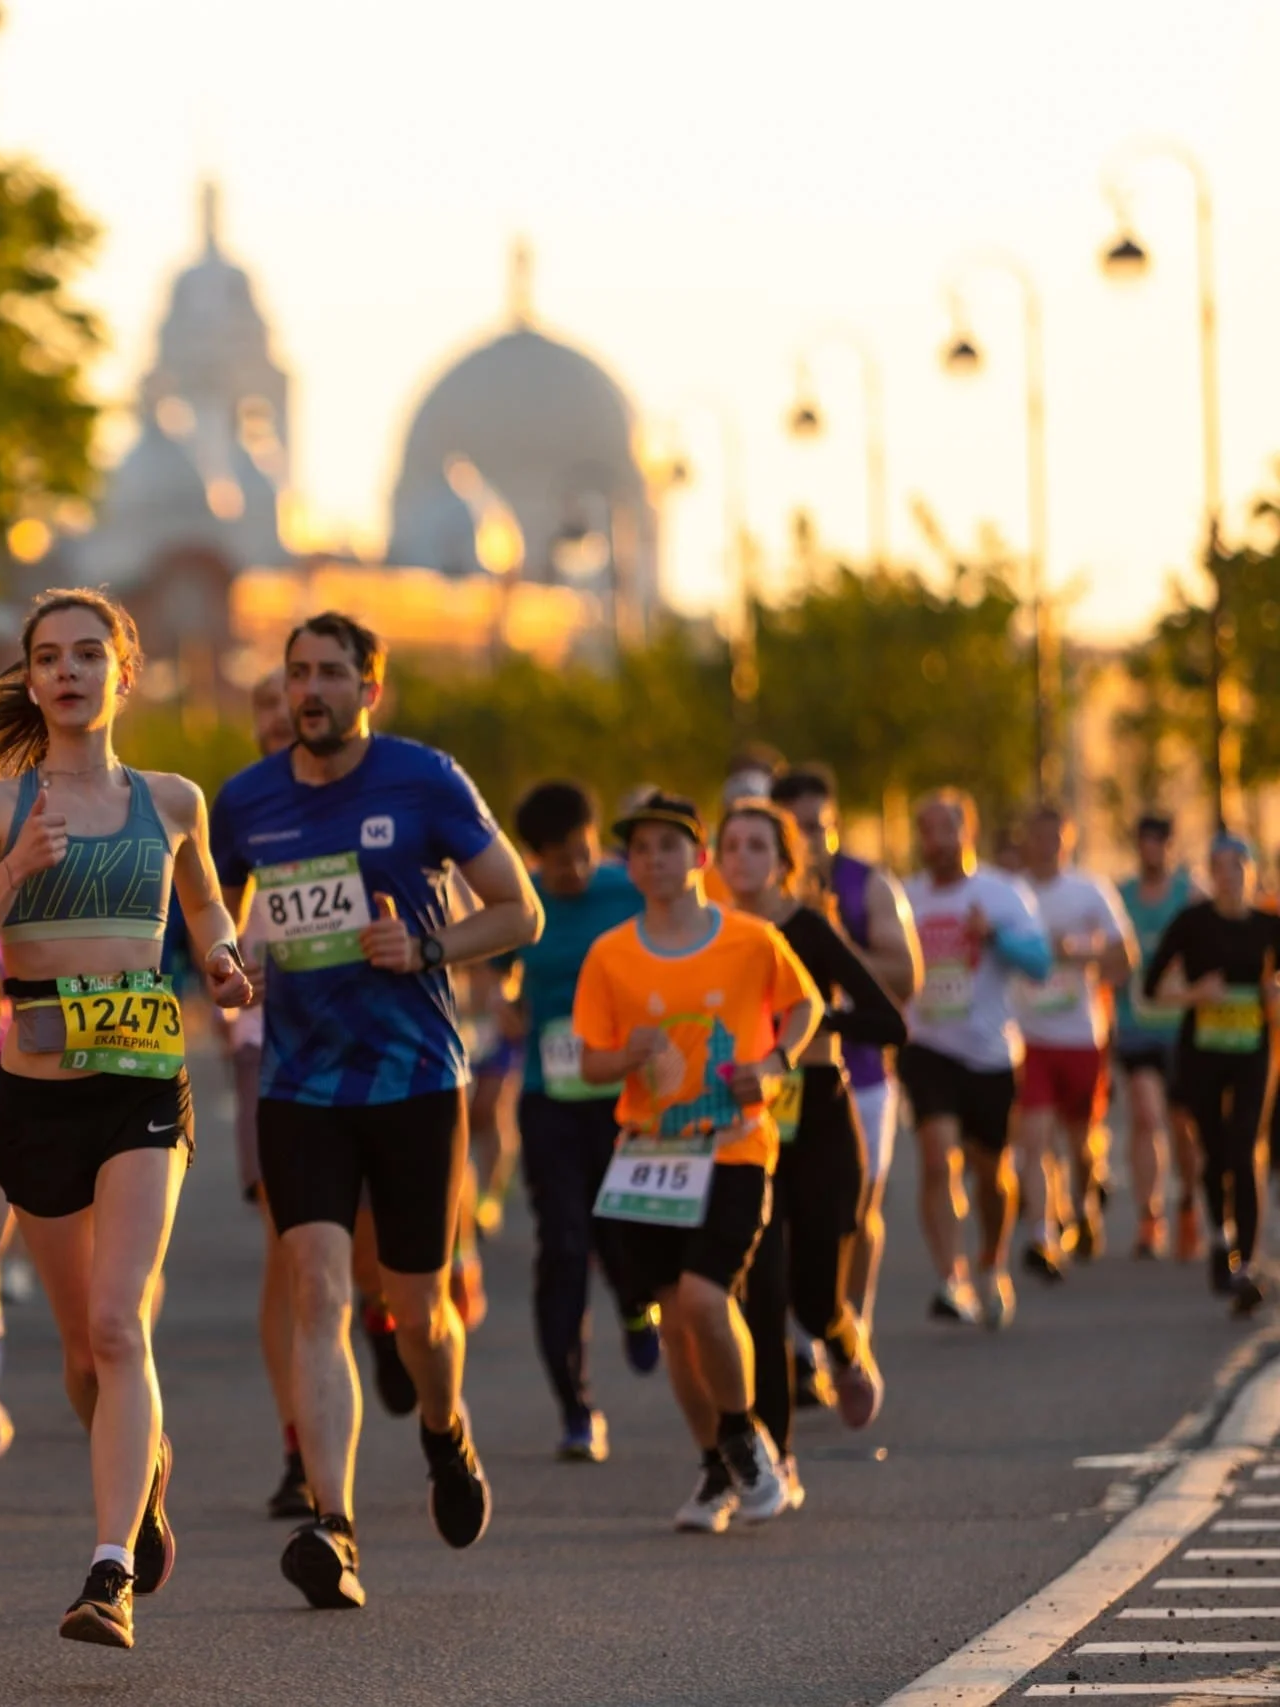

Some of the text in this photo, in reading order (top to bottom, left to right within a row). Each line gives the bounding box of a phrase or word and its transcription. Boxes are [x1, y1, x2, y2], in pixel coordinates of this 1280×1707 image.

[268, 881, 352, 925] 8124
[71, 976, 114, 992] БЛЫЕ
[69, 997, 180, 1036] 12473
[94, 1035, 160, 1049] ЕКАТЕРИНА
[630, 1161, 691, 1191] 815
